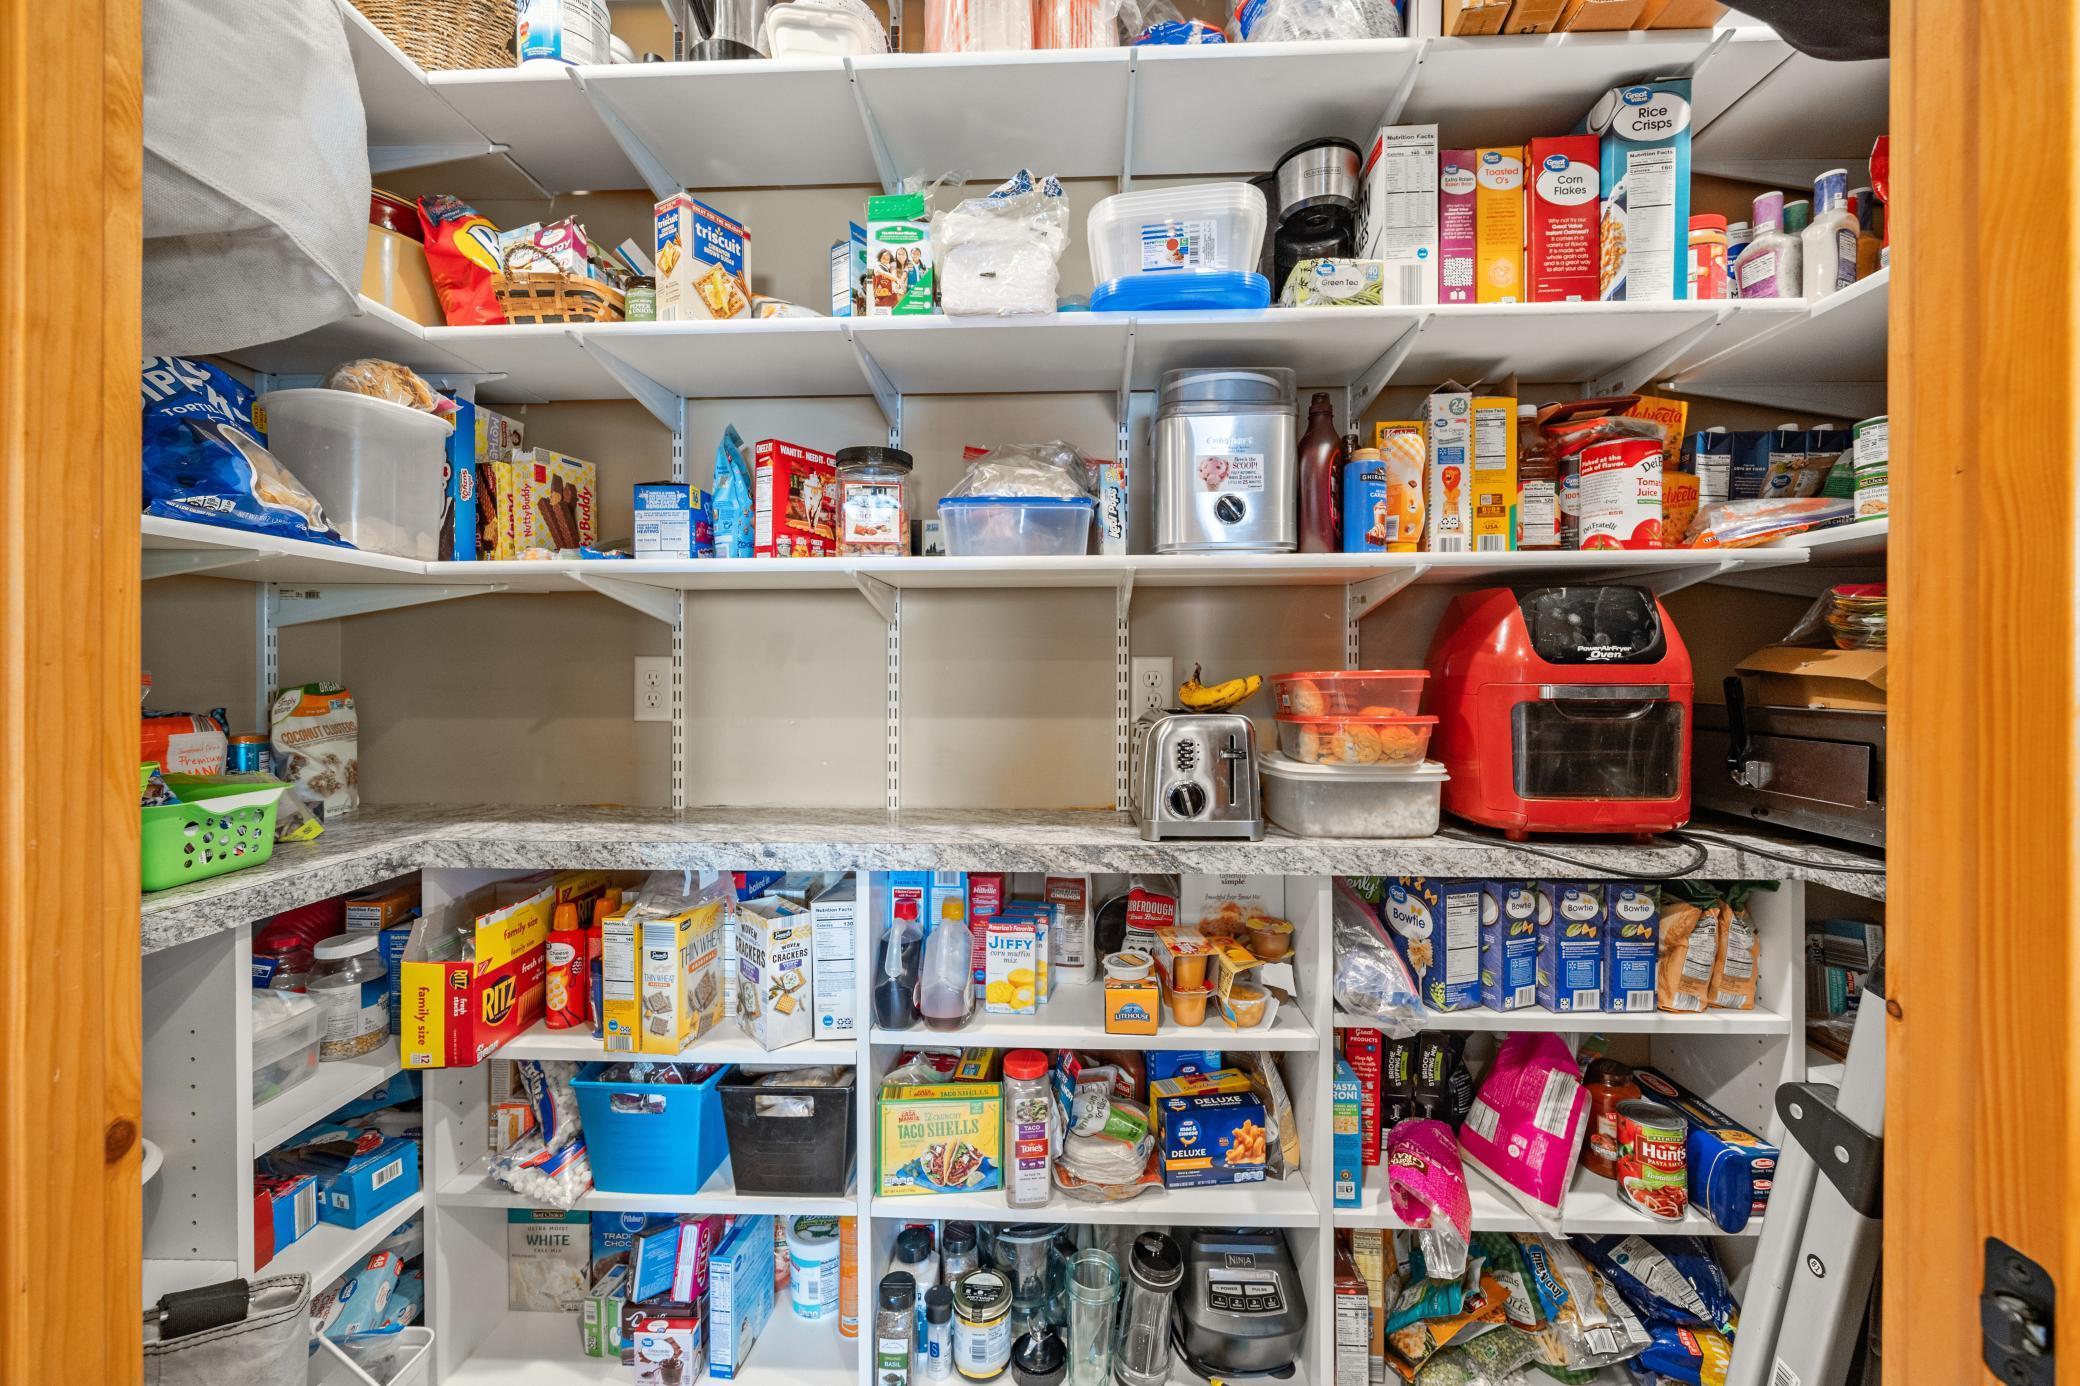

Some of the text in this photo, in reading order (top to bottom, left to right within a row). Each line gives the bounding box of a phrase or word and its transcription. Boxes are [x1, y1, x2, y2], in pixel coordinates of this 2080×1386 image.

[1625, 90, 1649, 100] Great
[1638, 107, 1668, 118] Rice
[1632, 119, 1673, 132] Crisps
[1546, 158, 1567, 166] Great
[1485, 168, 1519, 176] Toasted
[1496, 177, 1509, 185] O's
[1557, 175, 1584, 185] Corn
[1554, 186, 1587, 196] Flakes
[658, 214, 679, 229] triscuit
[696, 223, 742, 257] triscuit
[1368, 266, 1378, 274] 40
[1452, 399, 1465, 409] 24
[780, 445, 819, 463] WANT NEED
[1232, 461, 1258, 469] SCOOP!
[1581, 458, 1599, 467] Picked
[1641, 457, 1657, 473] Dei
[522, 483, 533, 511] Buddy
[1637, 487, 1658, 496] Juice
[577, 484, 593, 531] Buddy
[522, 510, 532, 537] Nutty
[1590, 650, 1622, 658] Oven
[281, 720, 357, 745] COCONUT CLUSTERS
[748, 874, 771, 894] baked in
[1511, 901, 1532, 910] Bowtie
[1567, 904, 1594, 912] Bowtie
[1623, 904, 1650, 912] Bowtie
[1392, 907, 1426, 929] Bowtie
[504, 915, 539, 940] family size
[741, 924, 758, 939] WOVEN
[988, 924, 1013, 932] America's
[510, 938, 535, 956] family size
[680, 926, 723, 968] THIN WHEAT
[988, 935, 1033, 949] JIFFY
[736, 935, 765, 968] CRACKERS
[772, 949, 808, 963] CRACKERS
[1007, 950, 1031, 958] muffin
[522, 958, 537, 974] fresh
[454, 969, 469, 990] RITZ
[644, 973, 675, 983] THIN WHEAT
[414, 986, 430, 1023] family
[482, 976, 517, 1023] RITZ
[459, 998, 468, 1016] fresh
[1115, 1012, 1150, 1021] LITEHOUSE
[417, 1024, 429, 1046] size
[1355, 1028, 1374, 1036] Great
[420, 1054, 430, 1064] 12
[1388, 1051, 1396, 1079] BRIOCHE
[1422, 1051, 1430, 1079] BRIOCHE
[1394, 1057, 1402, 1087] STUFFING
[957, 1089, 989, 1097] SHELLS
[1194, 1095, 1243, 1105] DELUXE
[898, 1119, 979, 1139] TACO SHELLS
[1021, 1144, 1044, 1153] Tone's
[1171, 1148, 1207, 1158] DELUXE
[1642, 1142, 1686, 1161] Hunt's
[1647, 1158, 1667, 1168] PASTA
[623, 1215, 643, 1224] Pillsbury
[526, 1234, 571, 1246] WHITE
[1228, 1254, 1252, 1267] NINJA
